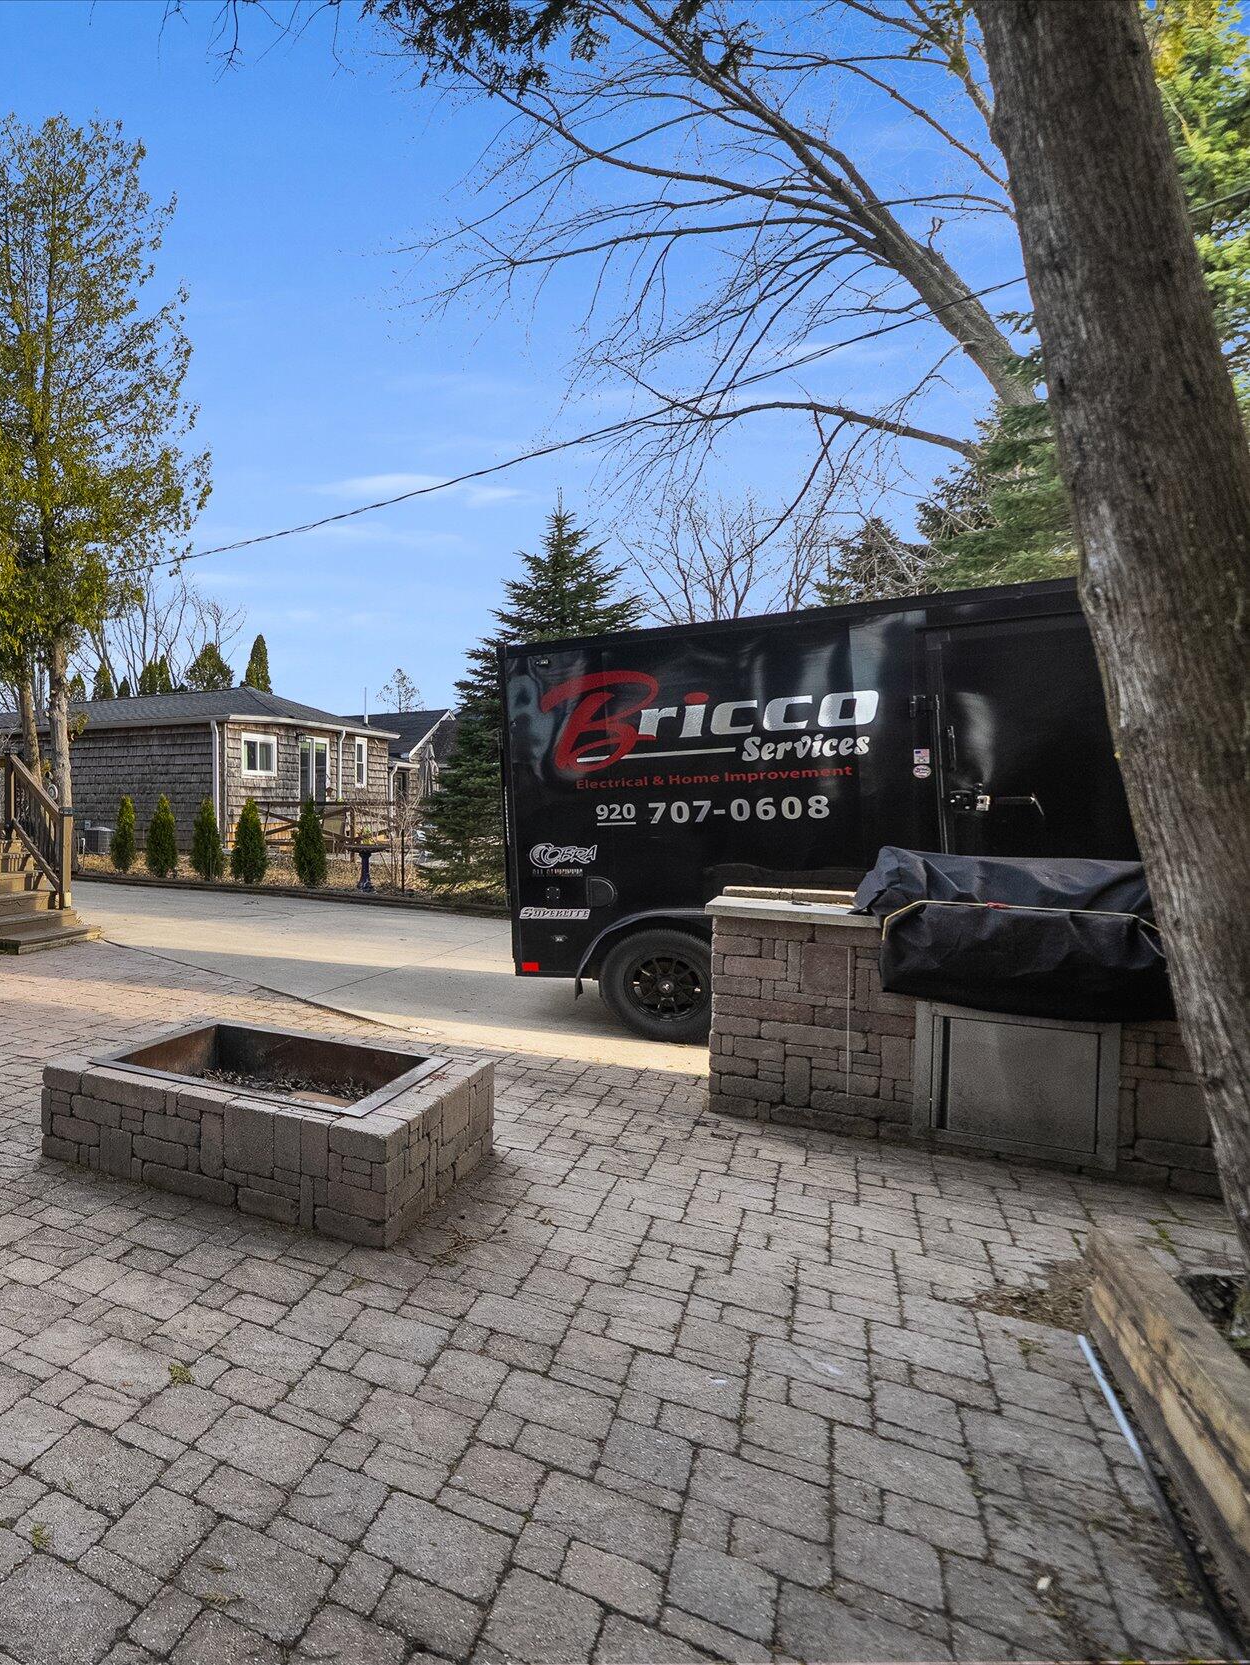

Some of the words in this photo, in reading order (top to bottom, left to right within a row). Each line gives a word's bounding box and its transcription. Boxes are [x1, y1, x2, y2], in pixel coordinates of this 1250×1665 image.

[540, 670, 879, 772] Bricco
[742, 734, 870, 761] Services
[576, 776, 648, 790] Electrical
[653, 775, 664, 786] &
[669, 772, 719, 785] Home
[725, 766, 853, 783] Improvement
[595, 803, 636, 821] 920
[648, 795, 830, 824] 707-0608
